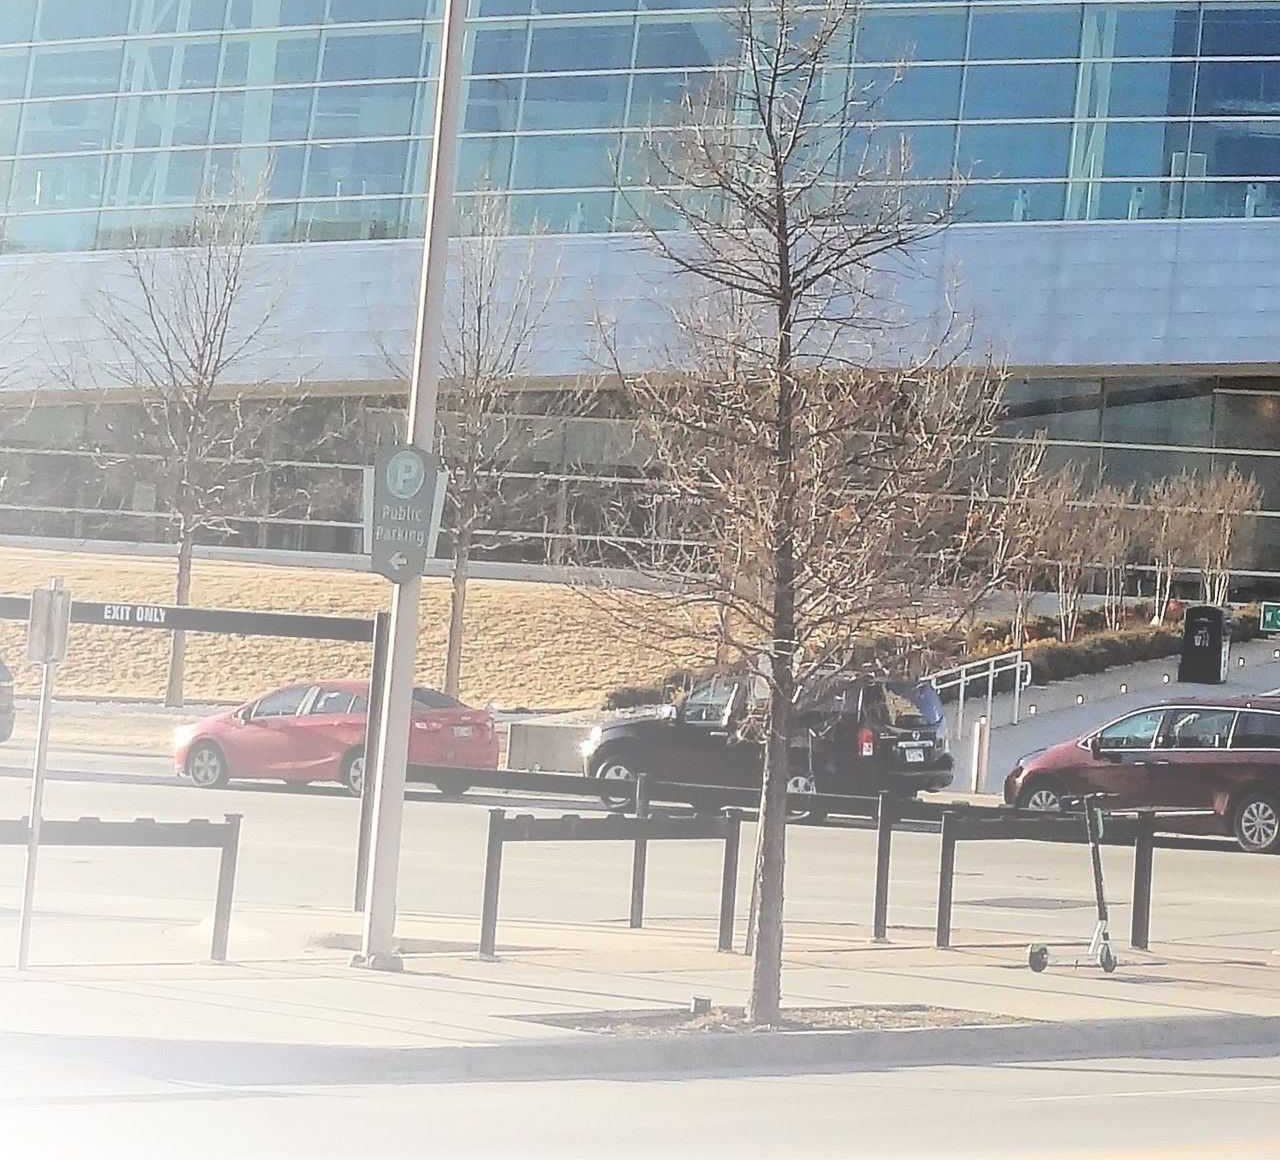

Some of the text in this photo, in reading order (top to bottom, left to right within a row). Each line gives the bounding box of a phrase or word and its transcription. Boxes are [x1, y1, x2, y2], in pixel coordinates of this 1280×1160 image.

[383, 505, 422, 521] Public
[375, 525, 425, 547] Parking
[103, 604, 166, 623] EXIT ONLY
